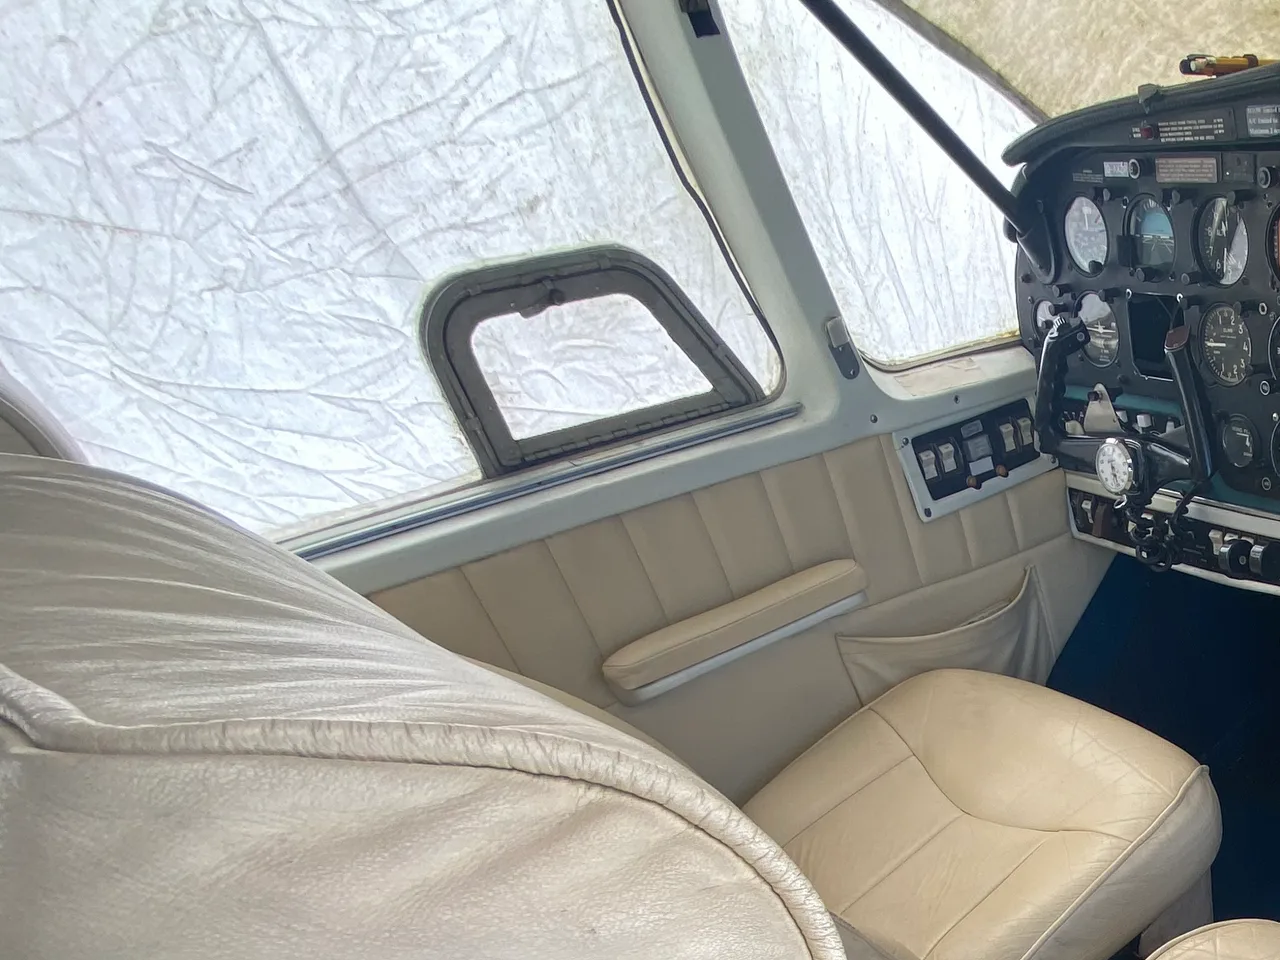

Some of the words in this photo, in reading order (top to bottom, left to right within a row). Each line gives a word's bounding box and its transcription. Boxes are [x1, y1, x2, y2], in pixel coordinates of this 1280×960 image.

[1231, 315, 1236, 326] 2
[1238, 325, 1244, 335] 3
[1240, 358, 1246, 369] 3
[1232, 364, 1238, 375] 2
